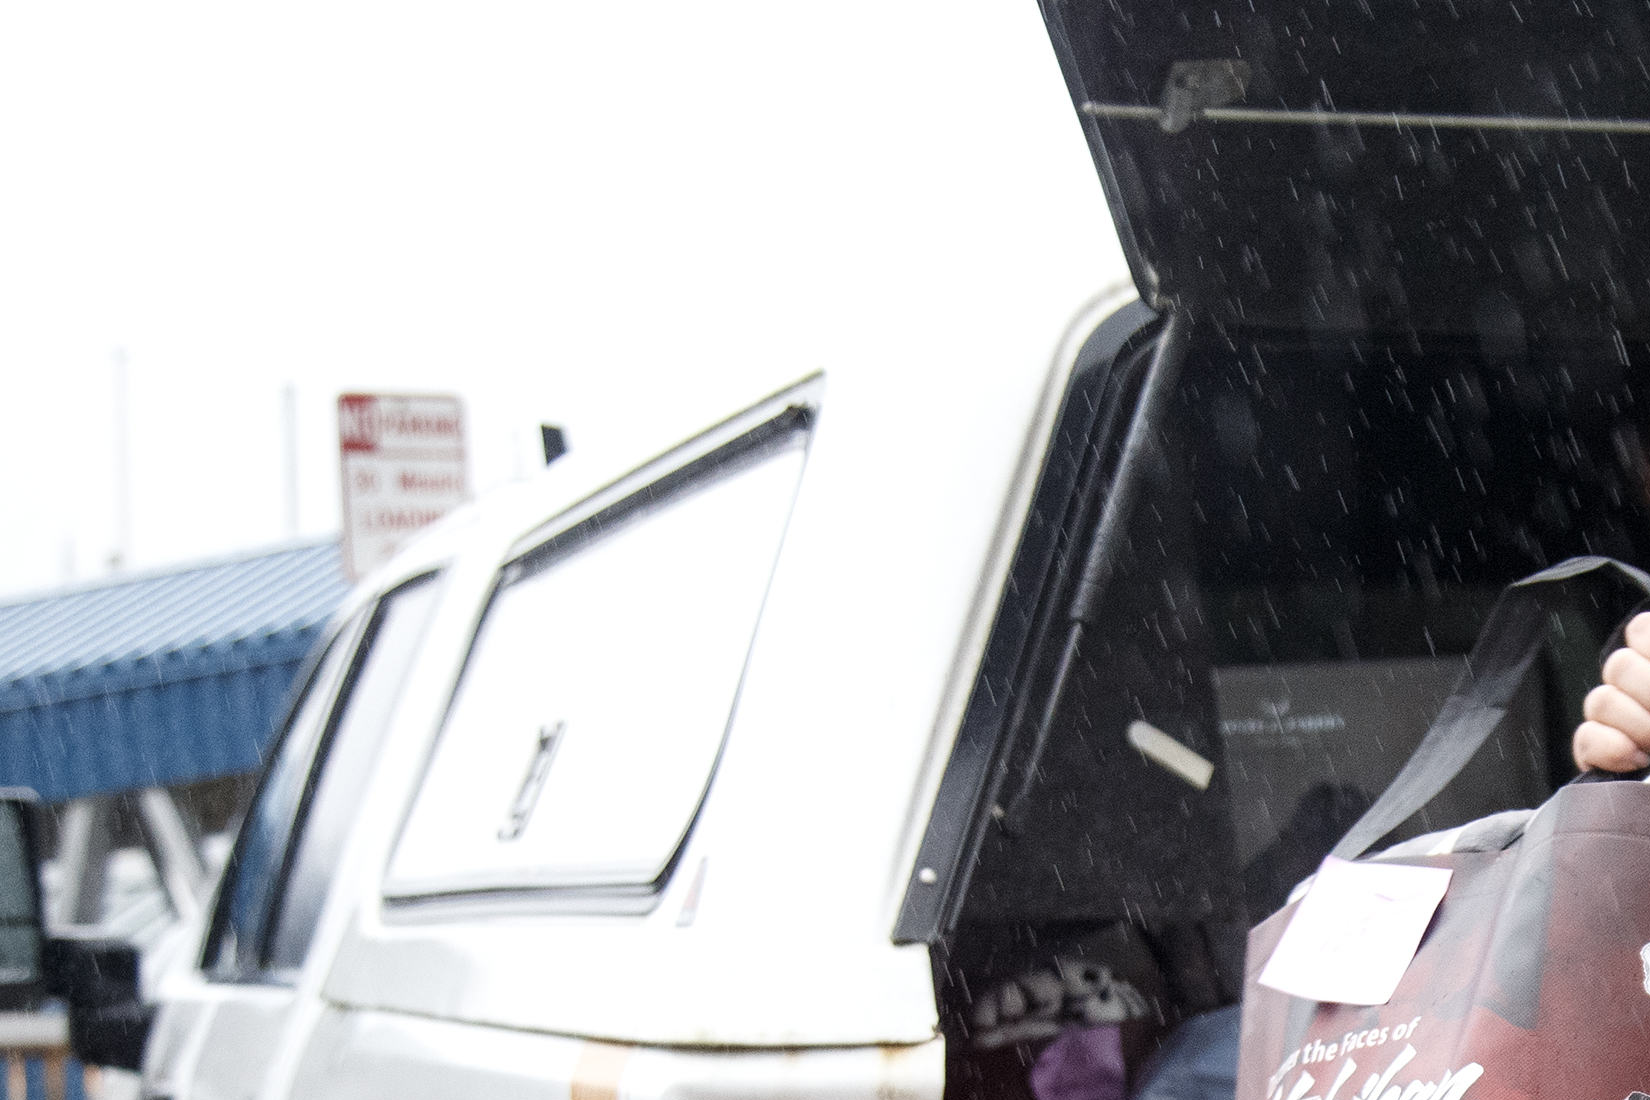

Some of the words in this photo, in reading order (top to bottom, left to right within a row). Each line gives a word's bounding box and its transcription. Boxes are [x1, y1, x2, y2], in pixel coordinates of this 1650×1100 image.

[1302, 1039, 1338, 1064] the
[1340, 1026, 1389, 1057] Faces
[1392, 1016, 1422, 1040] of
